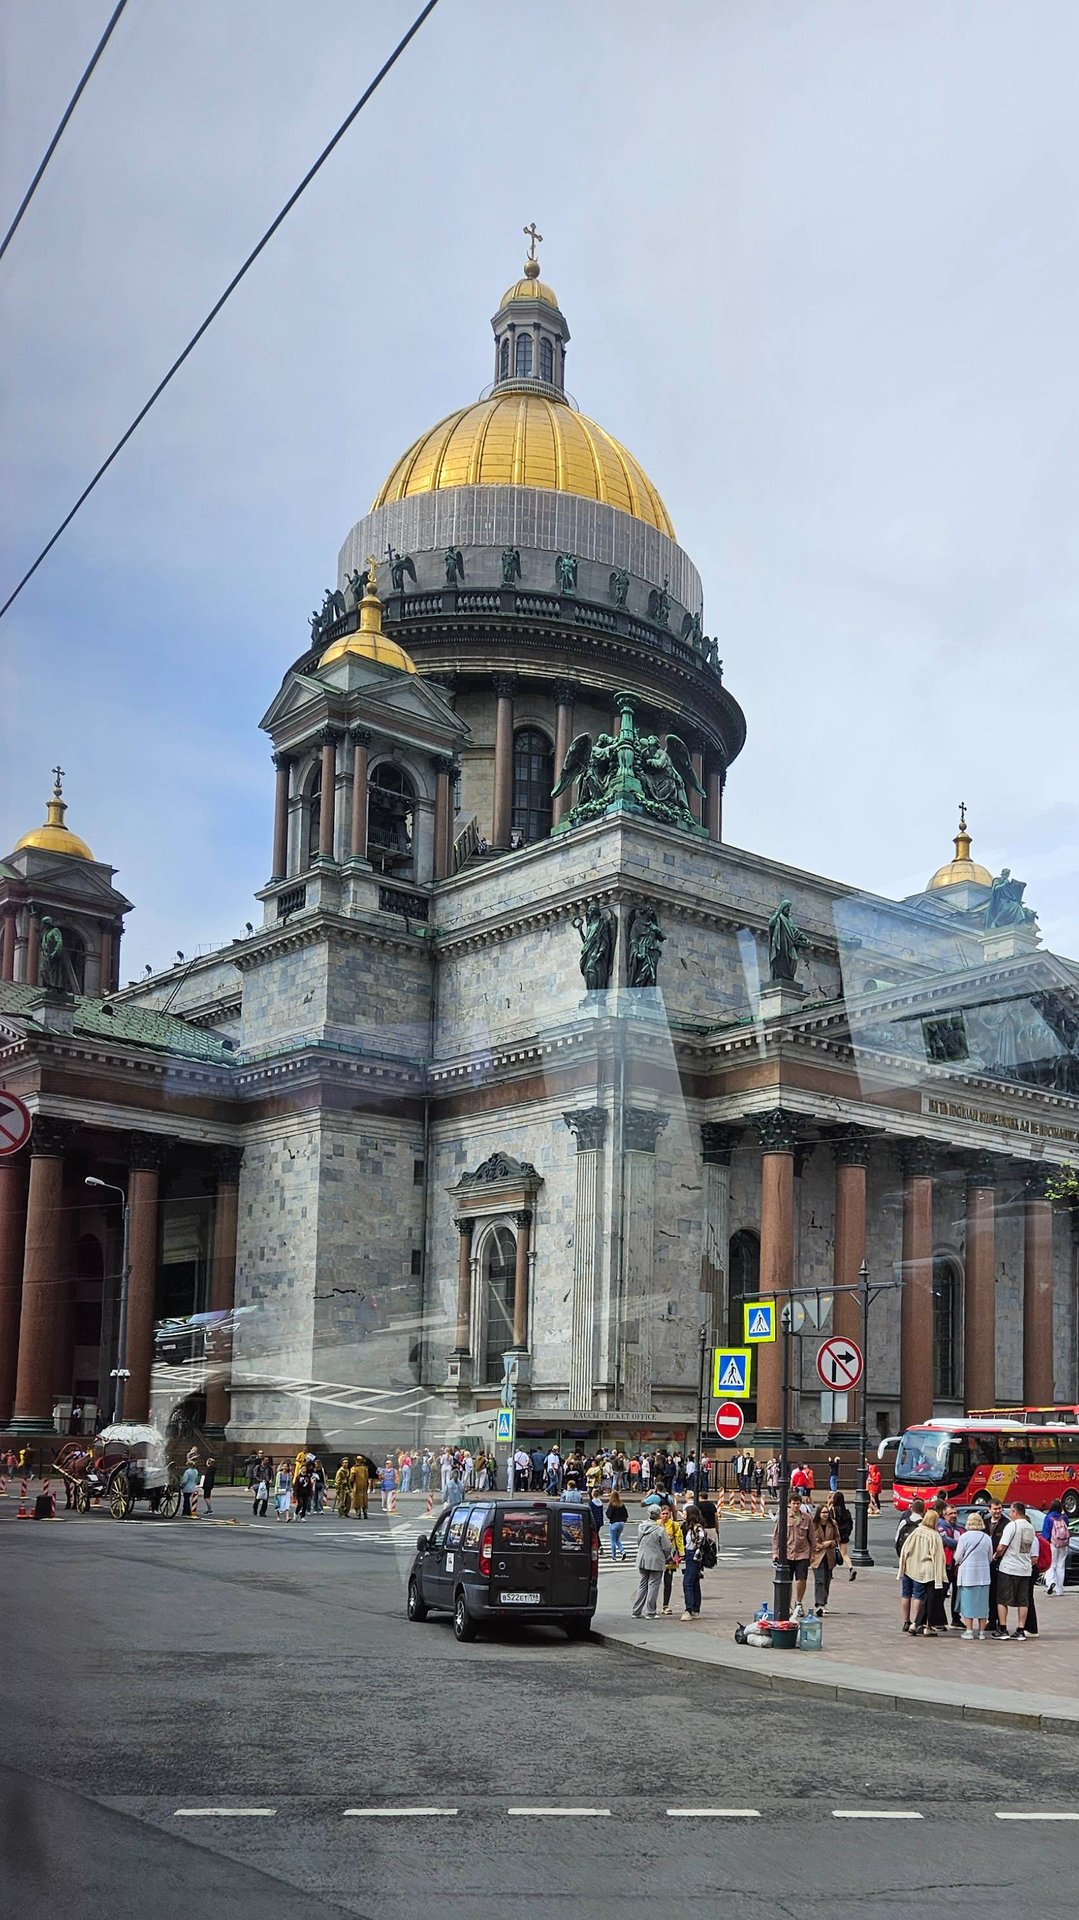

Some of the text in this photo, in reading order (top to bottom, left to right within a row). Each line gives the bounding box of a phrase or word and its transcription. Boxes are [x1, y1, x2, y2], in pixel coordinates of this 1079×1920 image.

[573, 1411, 600, 1419] КАССЫ
[605, 1412, 630, 1420] TICKET
[632, 1413, 657, 1421] OFFICE
